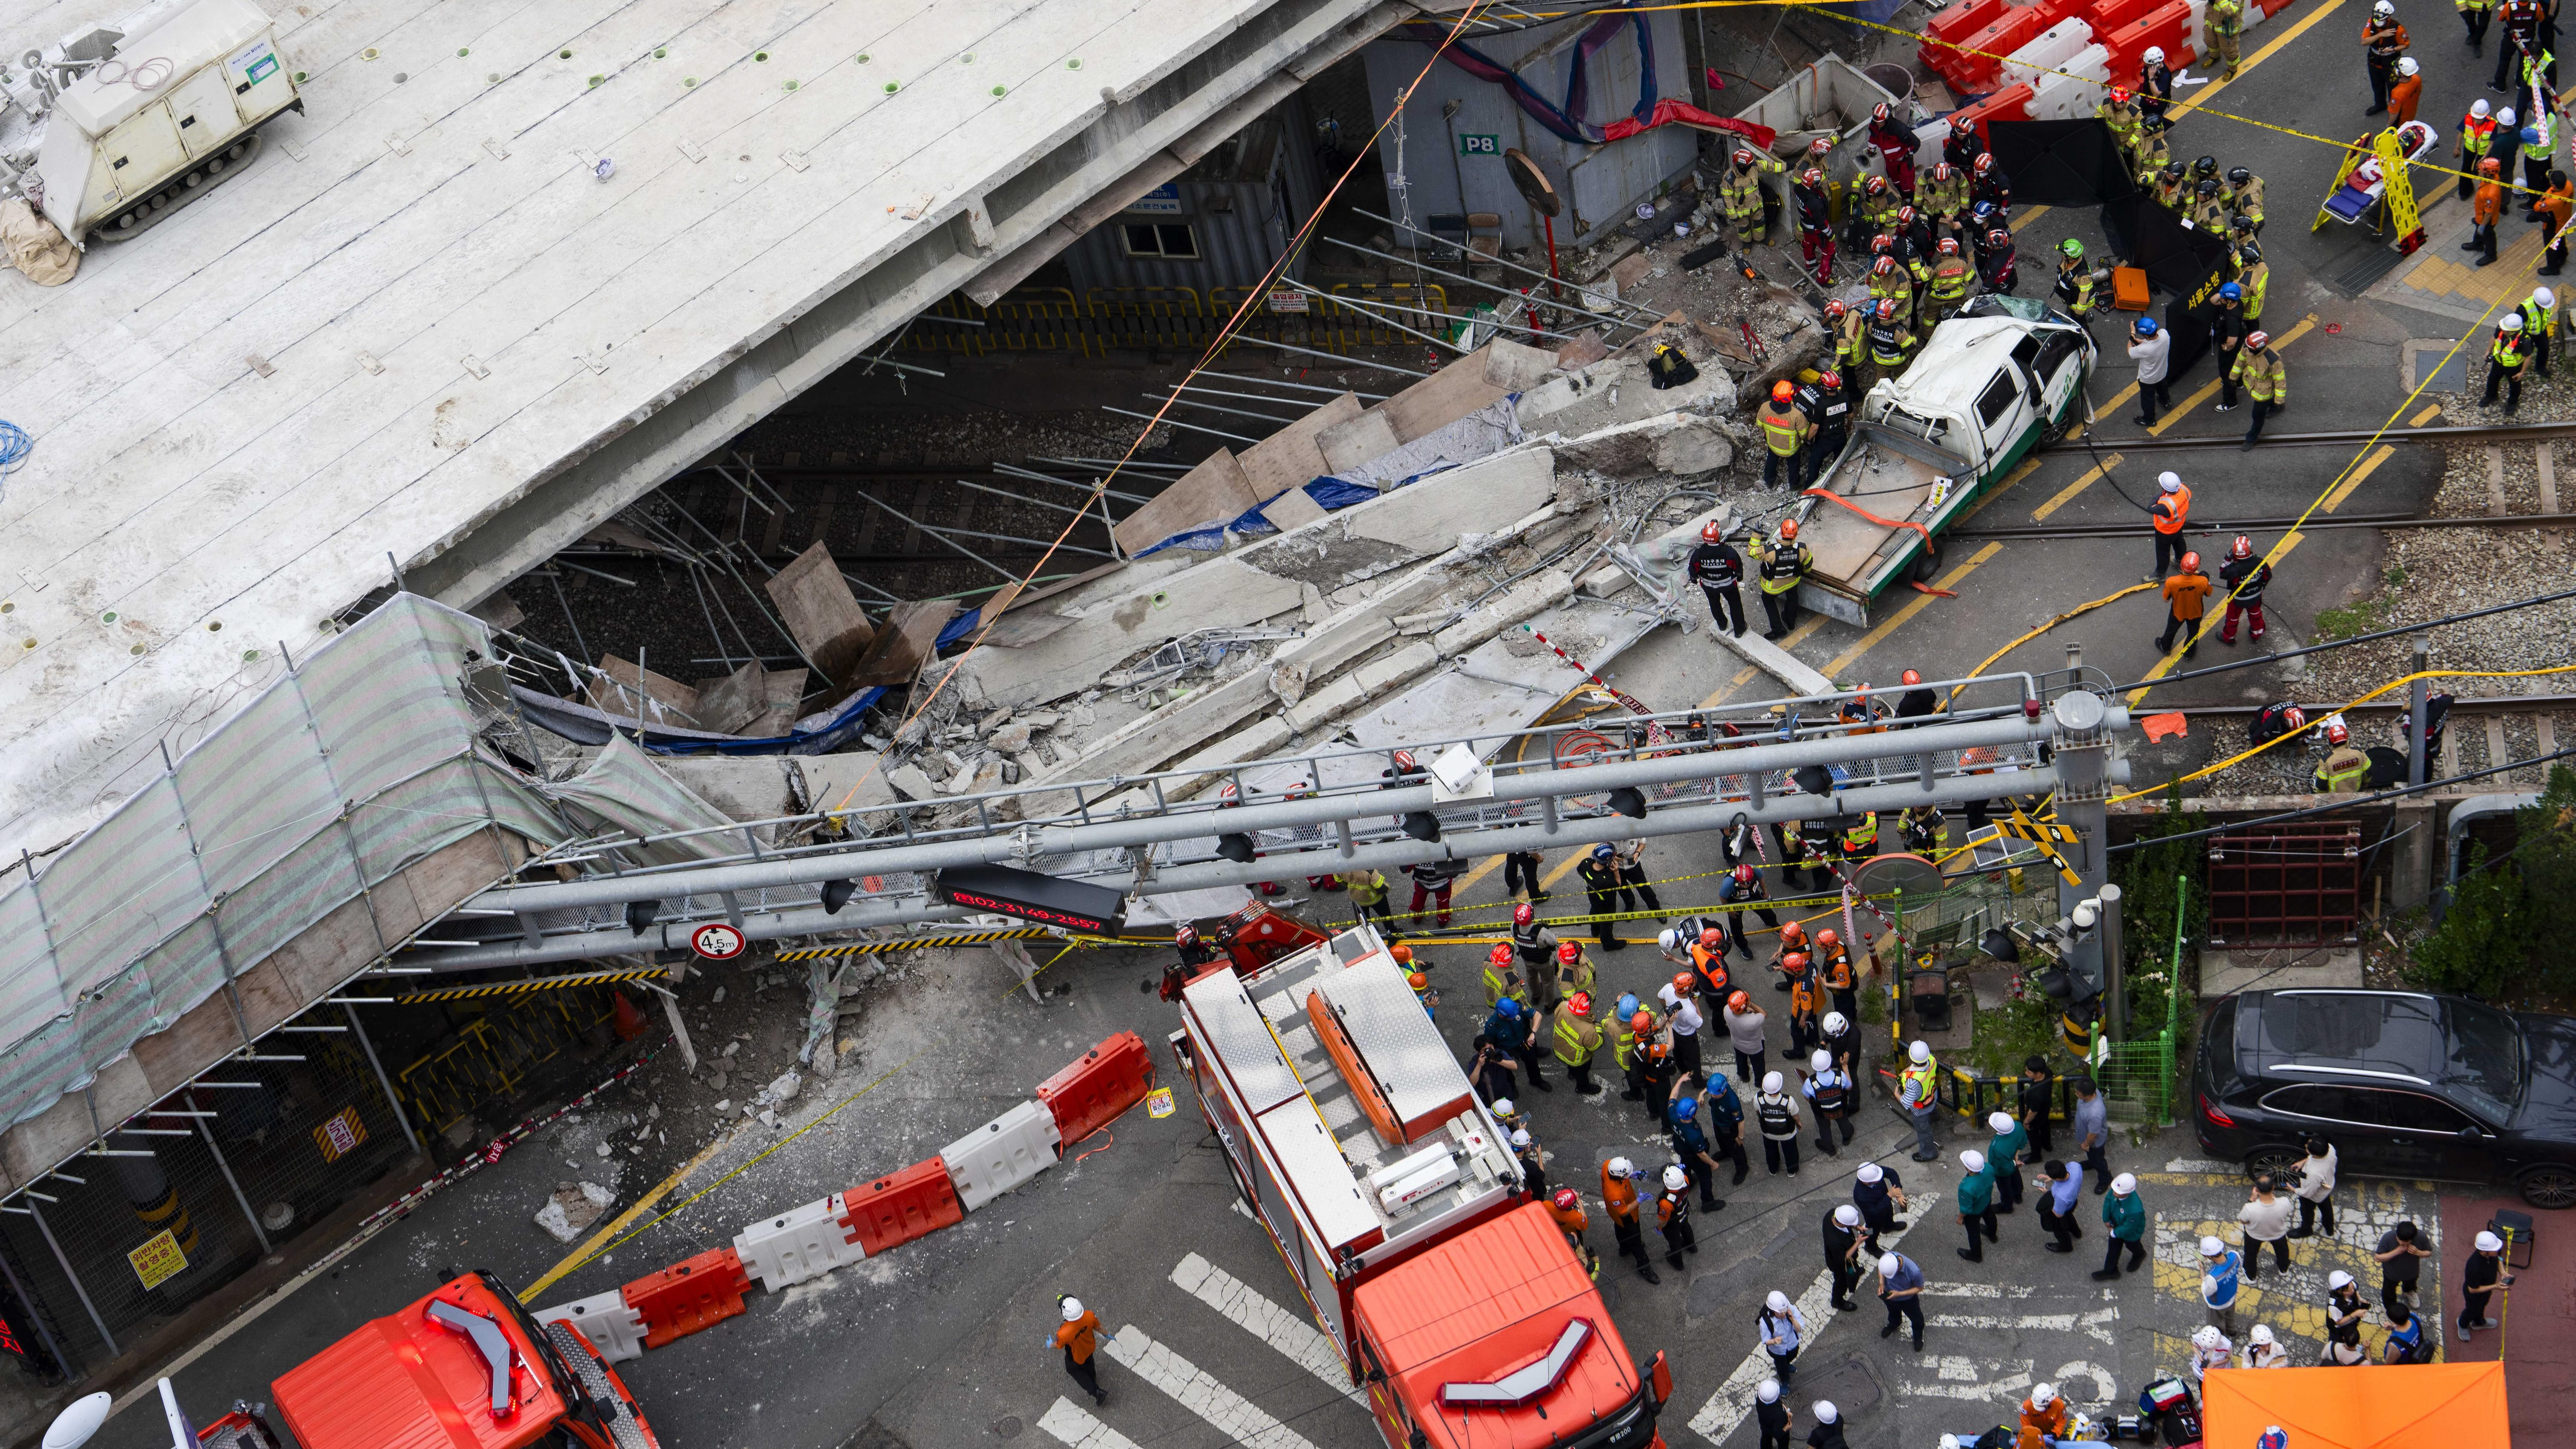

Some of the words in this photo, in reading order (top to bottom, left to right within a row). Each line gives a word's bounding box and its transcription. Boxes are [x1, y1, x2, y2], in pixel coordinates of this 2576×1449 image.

[1466, 137, 1494, 152] P8
[2188, 270, 2220, 310] 서울소방
[1806, 385, 1820, 398] 119구조
[1806, 389, 1817, 399] RESCU
[1622, 696, 1640, 710] 정지
[975, 896, 1101, 930] 02-3149-2557
[702, 935, 735, 949] 4.5m
[1153, 1102, 1170, 1111] 접근금지
[132, 1234, 170, 1262] 위반차량
[138, 1244, 175, 1272] 촬영중!
